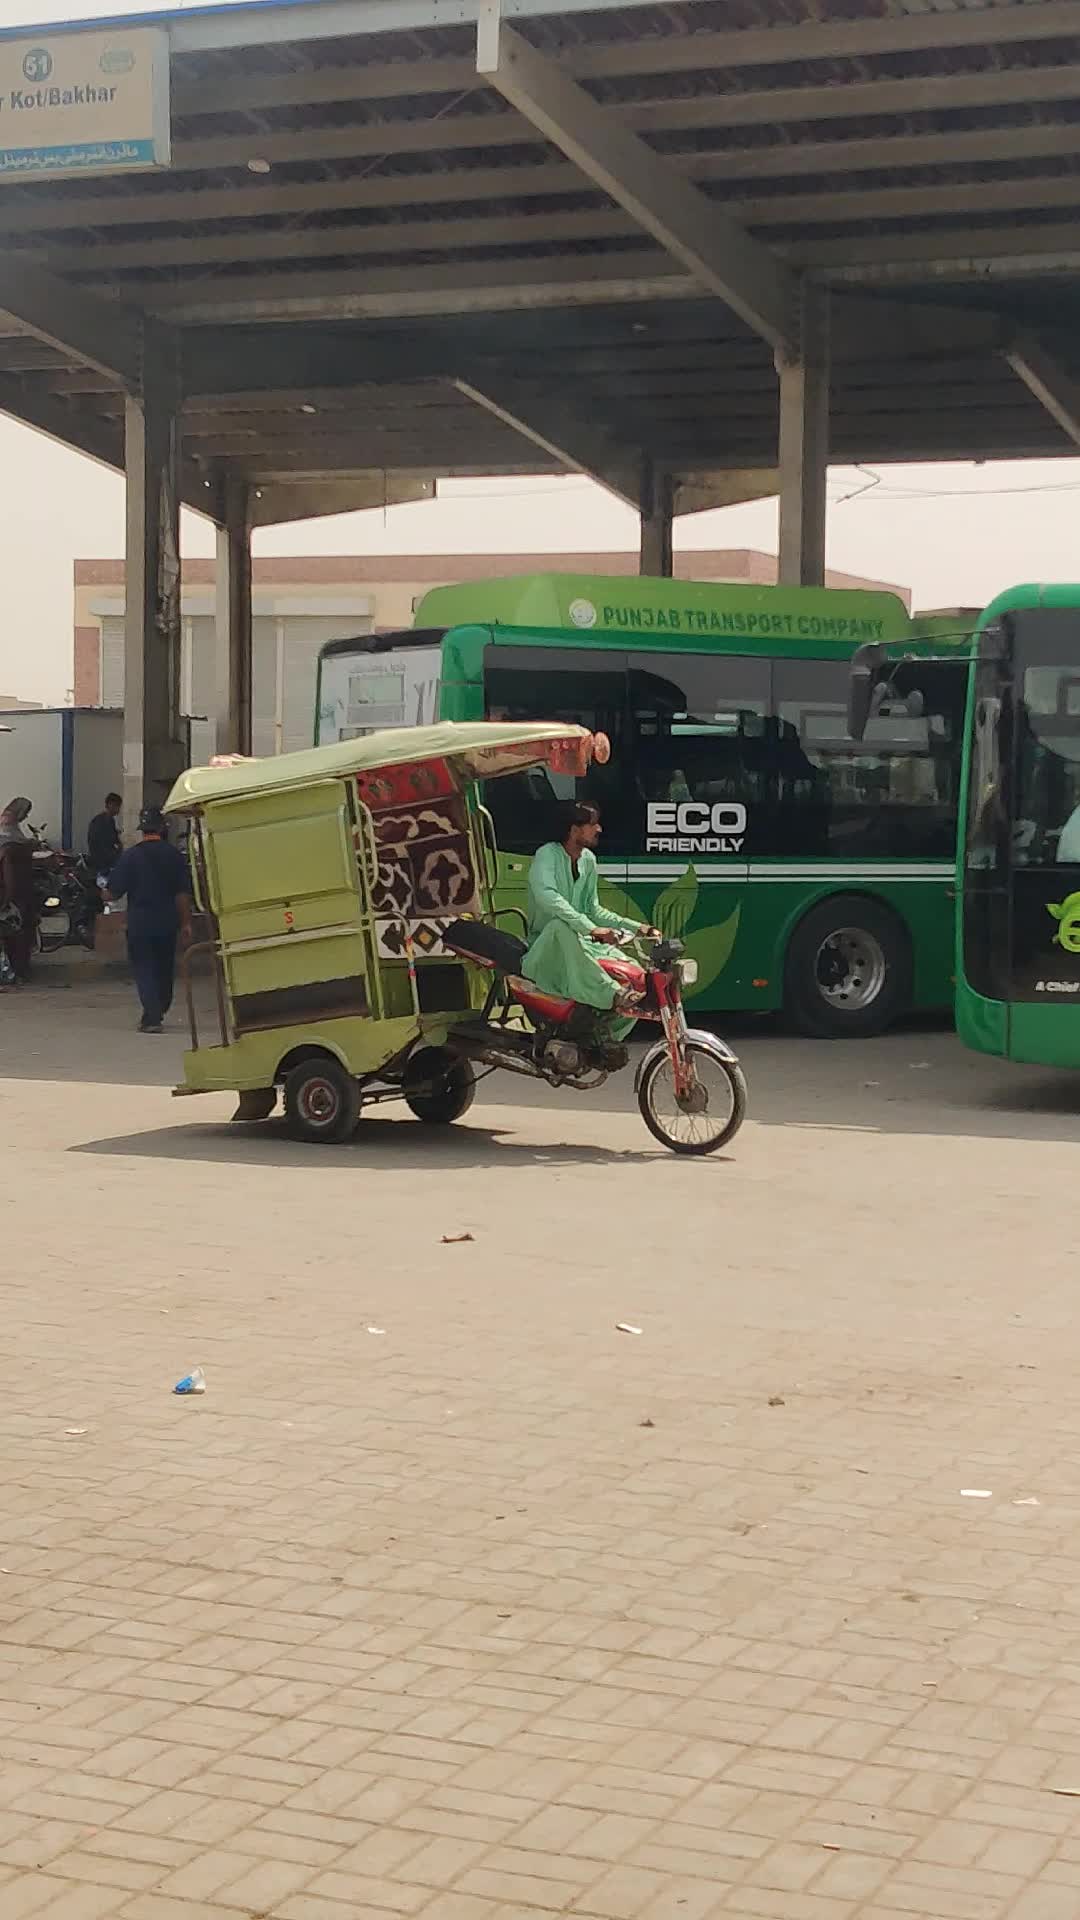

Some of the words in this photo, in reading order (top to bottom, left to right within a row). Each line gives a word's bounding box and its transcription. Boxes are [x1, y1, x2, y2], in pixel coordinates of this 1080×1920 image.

[604, 607, 680, 628] PUNJAB
[687, 610, 793, 634] TRANSPORT
[798, 616, 884, 638] COMPANY
[646, 802, 747, 834] ECO
[646, 838, 744, 852] FRIENDLY
